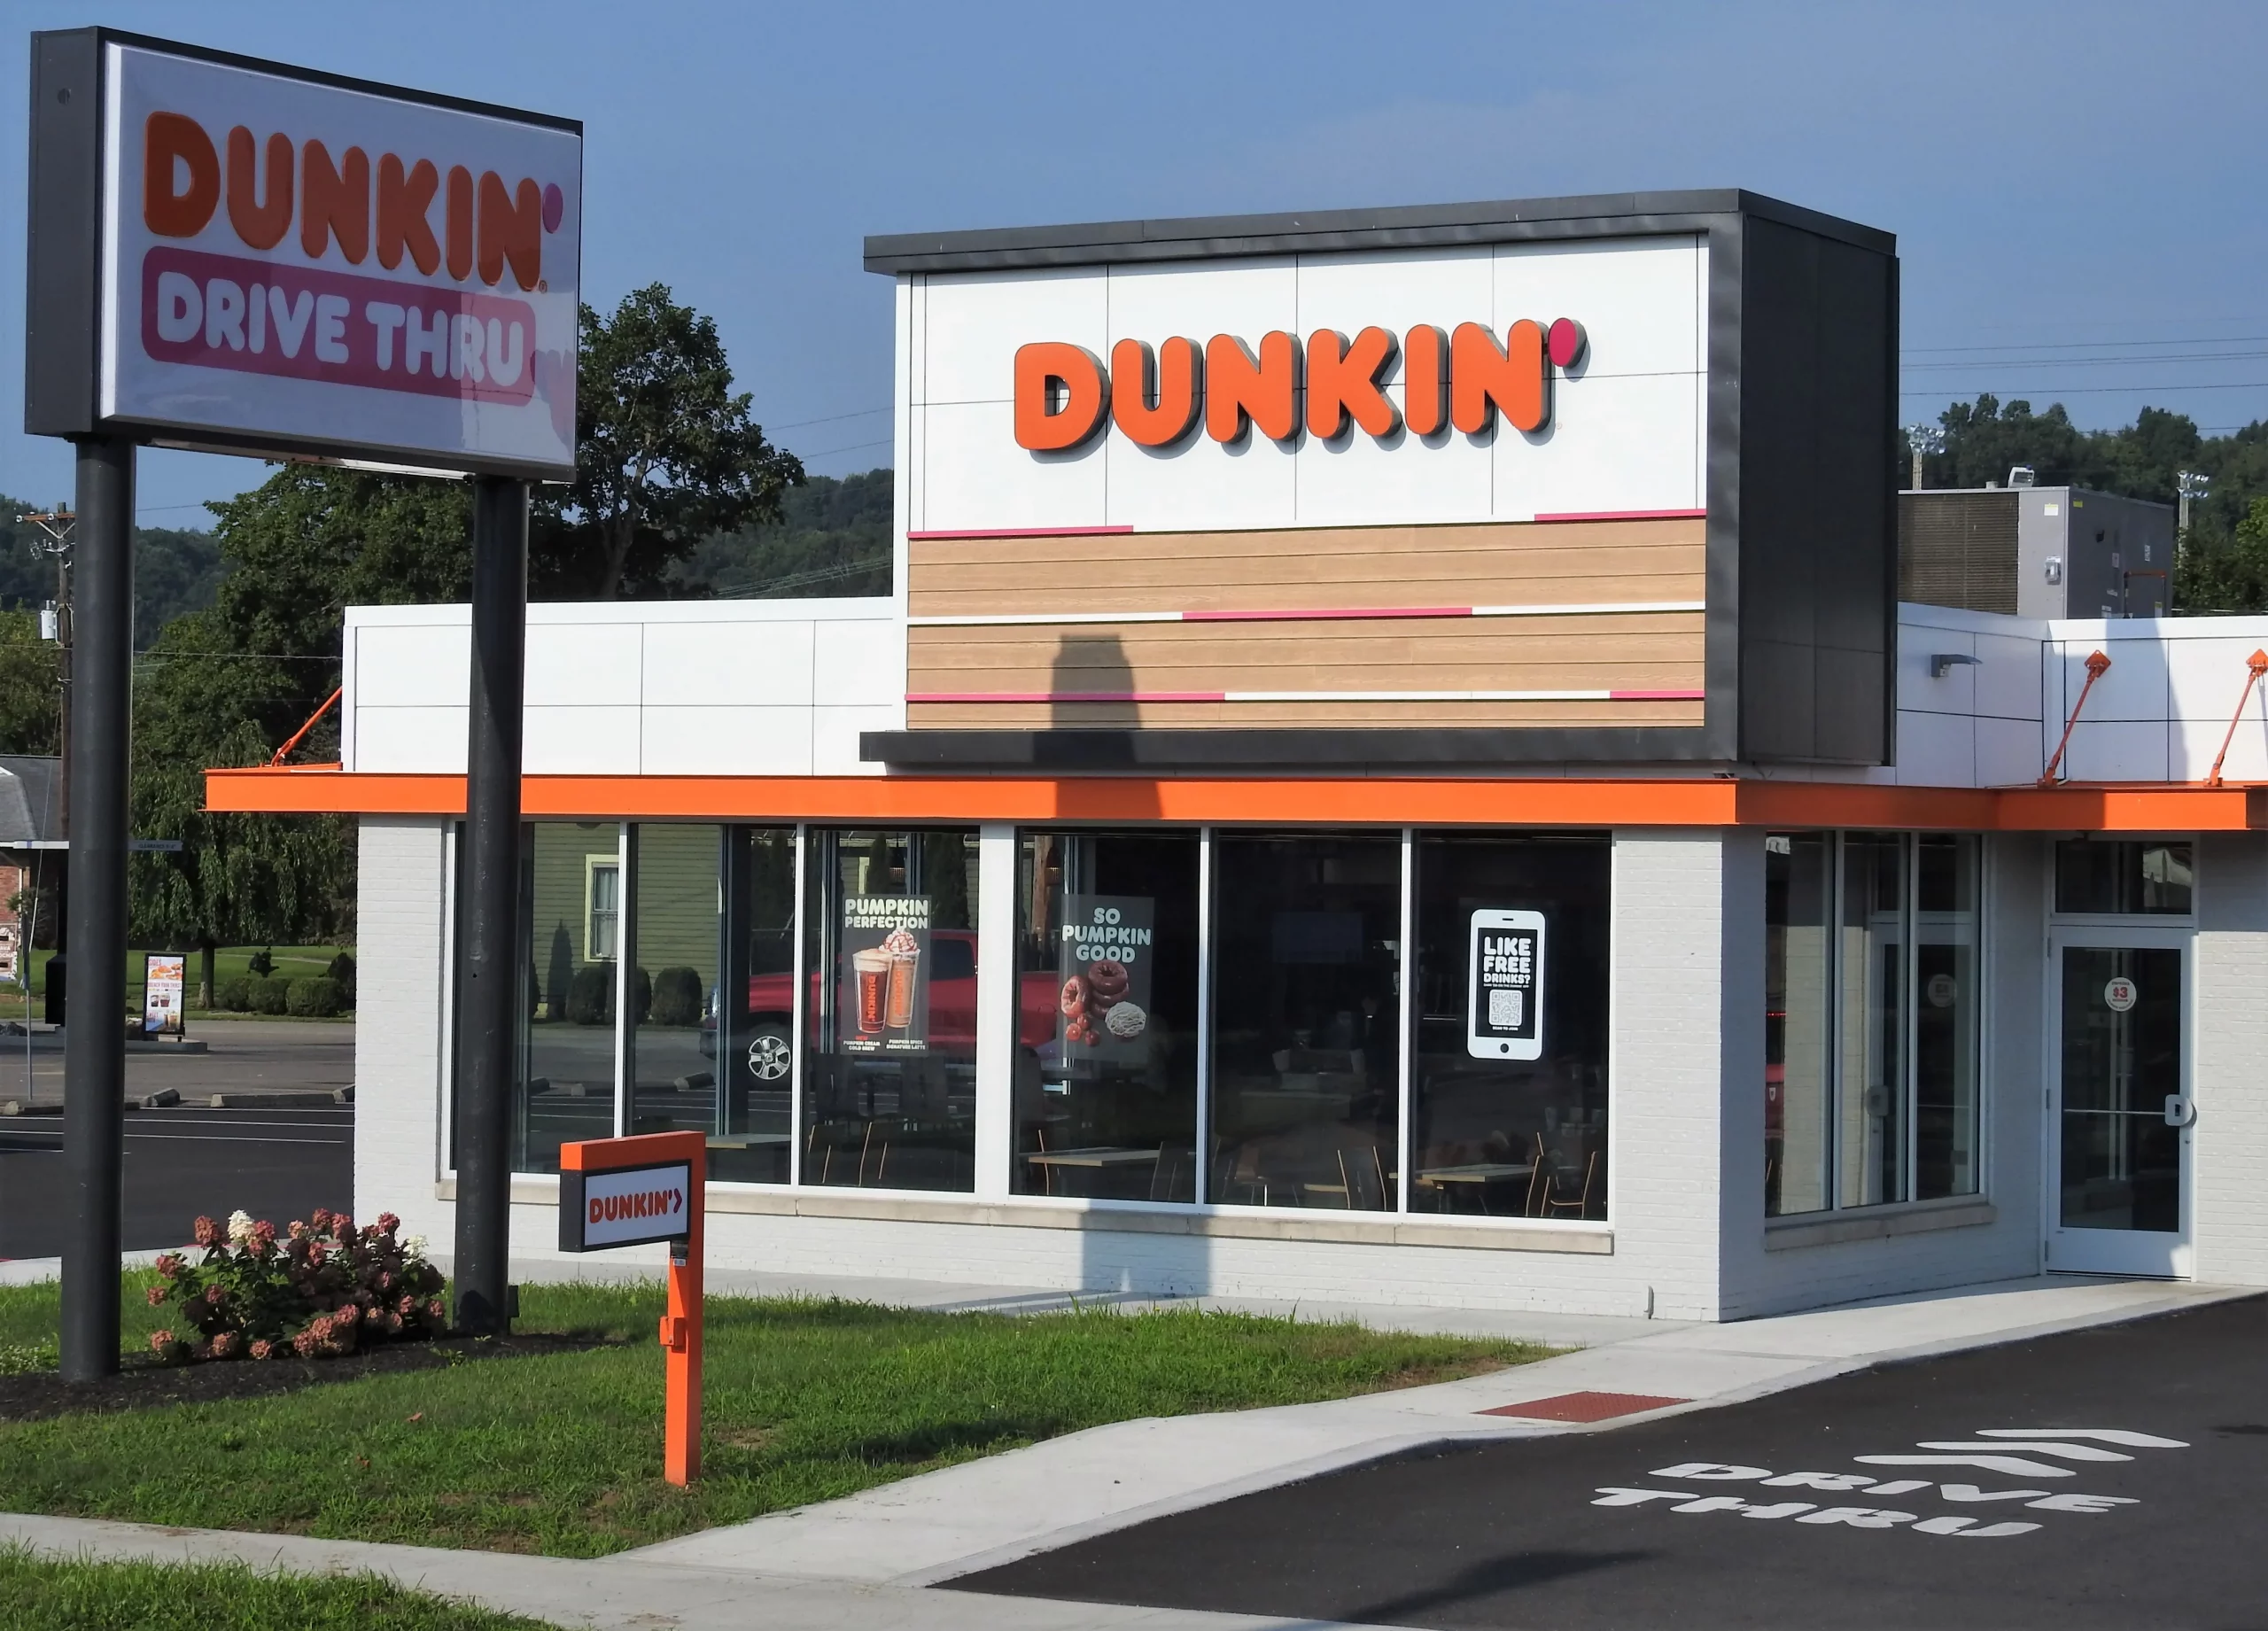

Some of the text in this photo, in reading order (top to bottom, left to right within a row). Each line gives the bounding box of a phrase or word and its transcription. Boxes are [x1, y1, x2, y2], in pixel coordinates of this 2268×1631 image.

[144, 110, 564, 292] DUNKIN'
[157, 270, 524, 387] DRIVE THRU
[1014, 317, 1584, 452] DUNKIN'
[844, 898, 928, 916] PUMPKIN
[1093, 907, 1121, 925] SO
[844, 916, 928, 929] PERFECTION
[1061, 925, 1152, 946] PUMPKIN
[1076, 944, 1136, 963] GOOD
[1484, 936, 1531, 957] LIKE
[1483, 955, 1531, 974] FREE
[1483, 973, 1531, 985] DRINKS?
[589, 1190, 673, 1224] DUNKIN'
[1647, 1462, 2141, 1513] DRIVE
[1589, 1487, 2044, 1537] THRU
